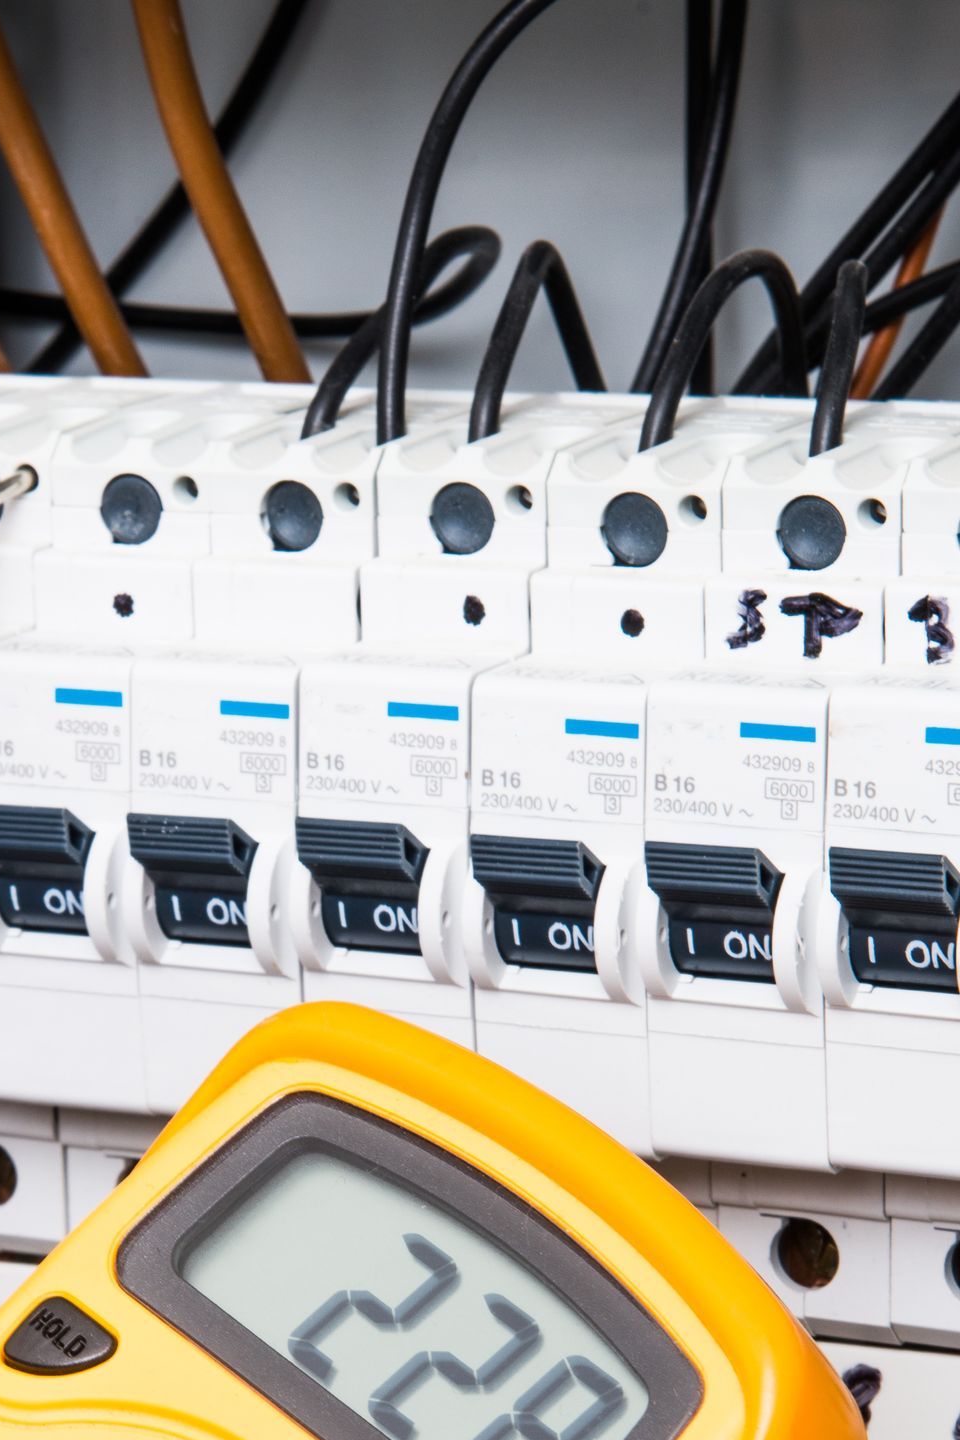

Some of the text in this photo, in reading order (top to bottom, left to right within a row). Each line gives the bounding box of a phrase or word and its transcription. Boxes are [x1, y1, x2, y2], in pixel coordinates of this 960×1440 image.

[55, 719, 108, 736] 432909
[219, 730, 274, 747] 432909
[389, 732, 446, 750] 432909
[80, 745, 116, 760] 6000
[140, 750, 177, 768] B 16
[307, 752, 345, 770] B 16
[566, 750, 625, 768] 432909
[245, 757, 282, 772] 6000
[415, 760, 452, 776] 6000
[742, 754, 802, 773] 432909
[138, 773, 214, 791] 230/400 V
[306, 776, 382, 794] 230/400 V
[481, 770, 522, 788] B 16
[593, 777, 631, 793] 6000
[654, 774, 696, 794] B 16
[770, 782, 808, 798] 6000
[834, 779, 877, 799] B 16
[480, 793, 559, 812] 230/400 V
[654, 798, 734, 818] 230/400 V
[834, 803, 916, 823] 230/400 V
[44, 888, 84, 915] ON
[206, 898, 248, 926] ON
[373, 904, 419, 933] ON
[548, 922, 595, 951] ON
[724, 930, 772, 960] ON
[905, 940, 955, 970] ON
[30, 1307, 86, 1359] HOLD
